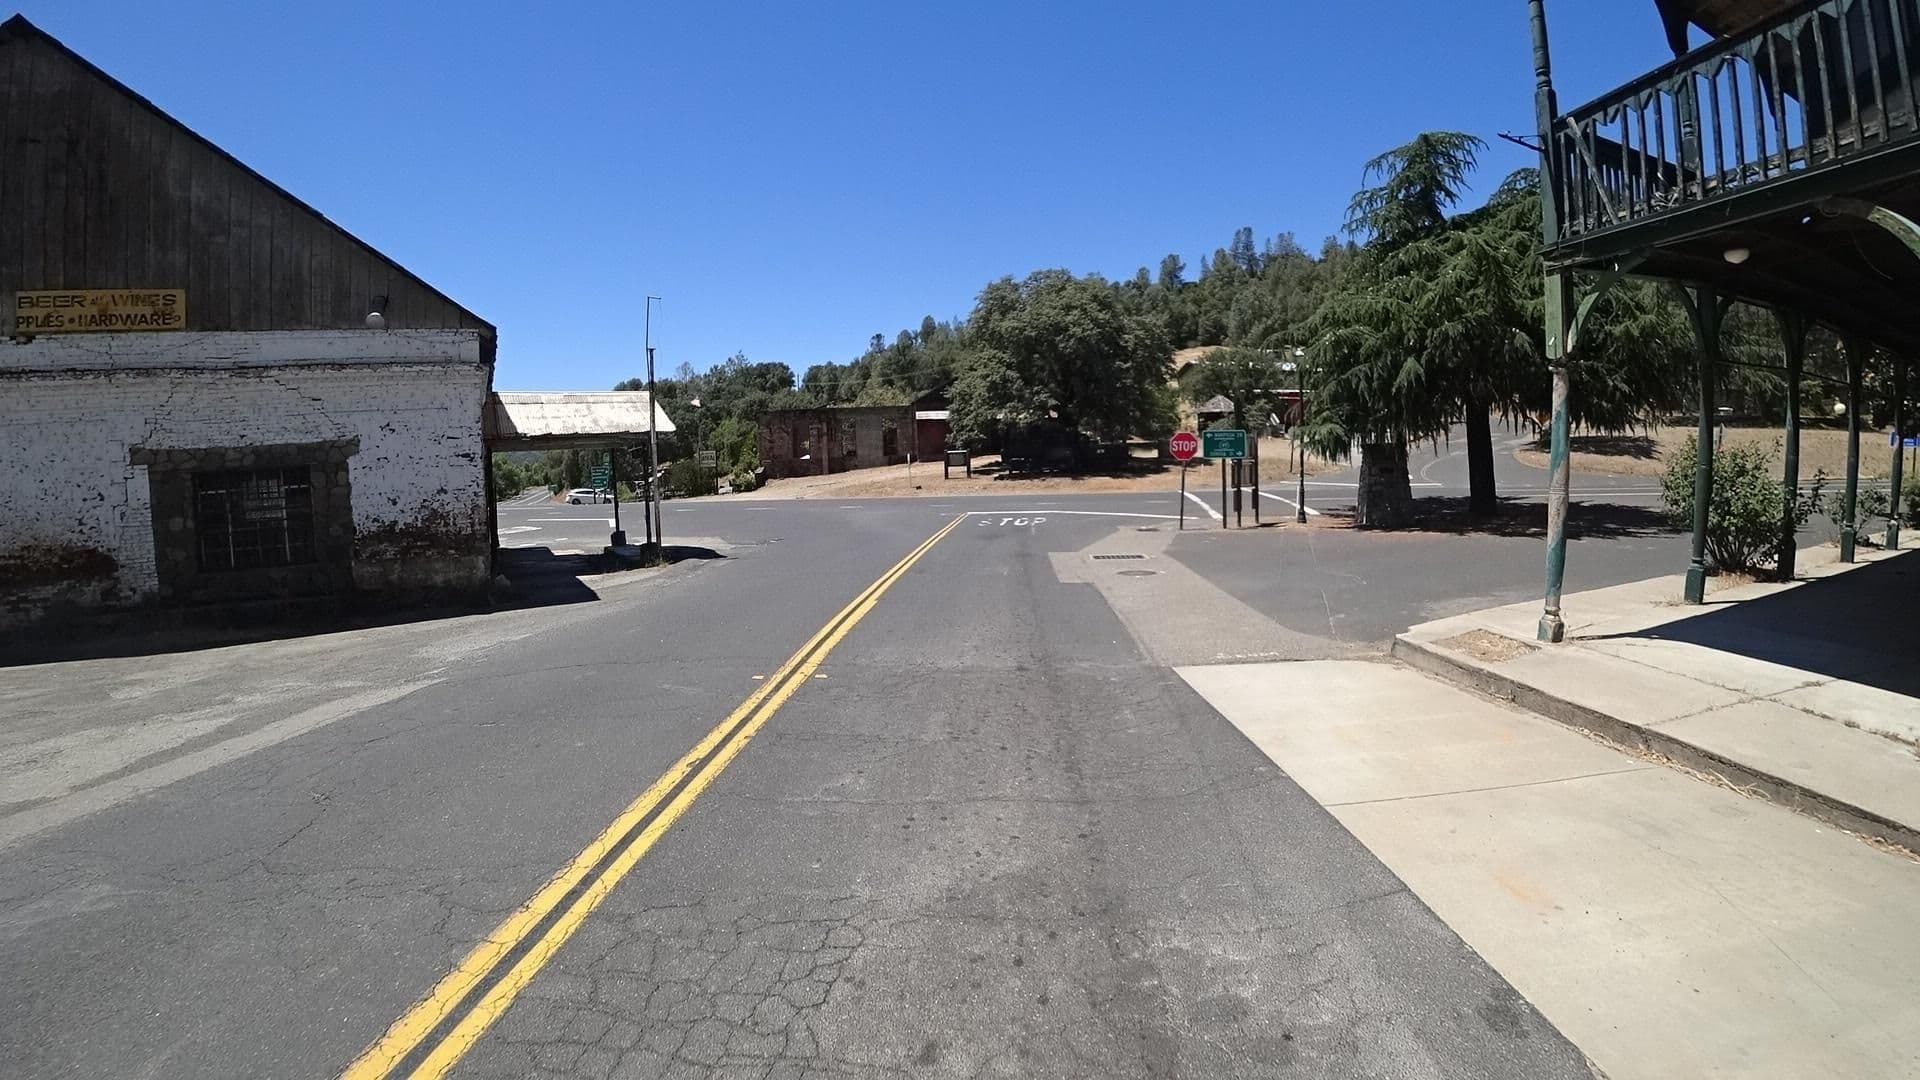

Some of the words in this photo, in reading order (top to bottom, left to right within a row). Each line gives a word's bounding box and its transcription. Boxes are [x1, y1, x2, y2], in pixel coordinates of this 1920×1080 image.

[18, 295, 87, 309] BEER
[110, 293, 177, 307] WINES
[78, 312, 174, 328] HARDWARE
[1172, 440, 1197, 452] STOP
[978, 517, 1047, 527] STOP
